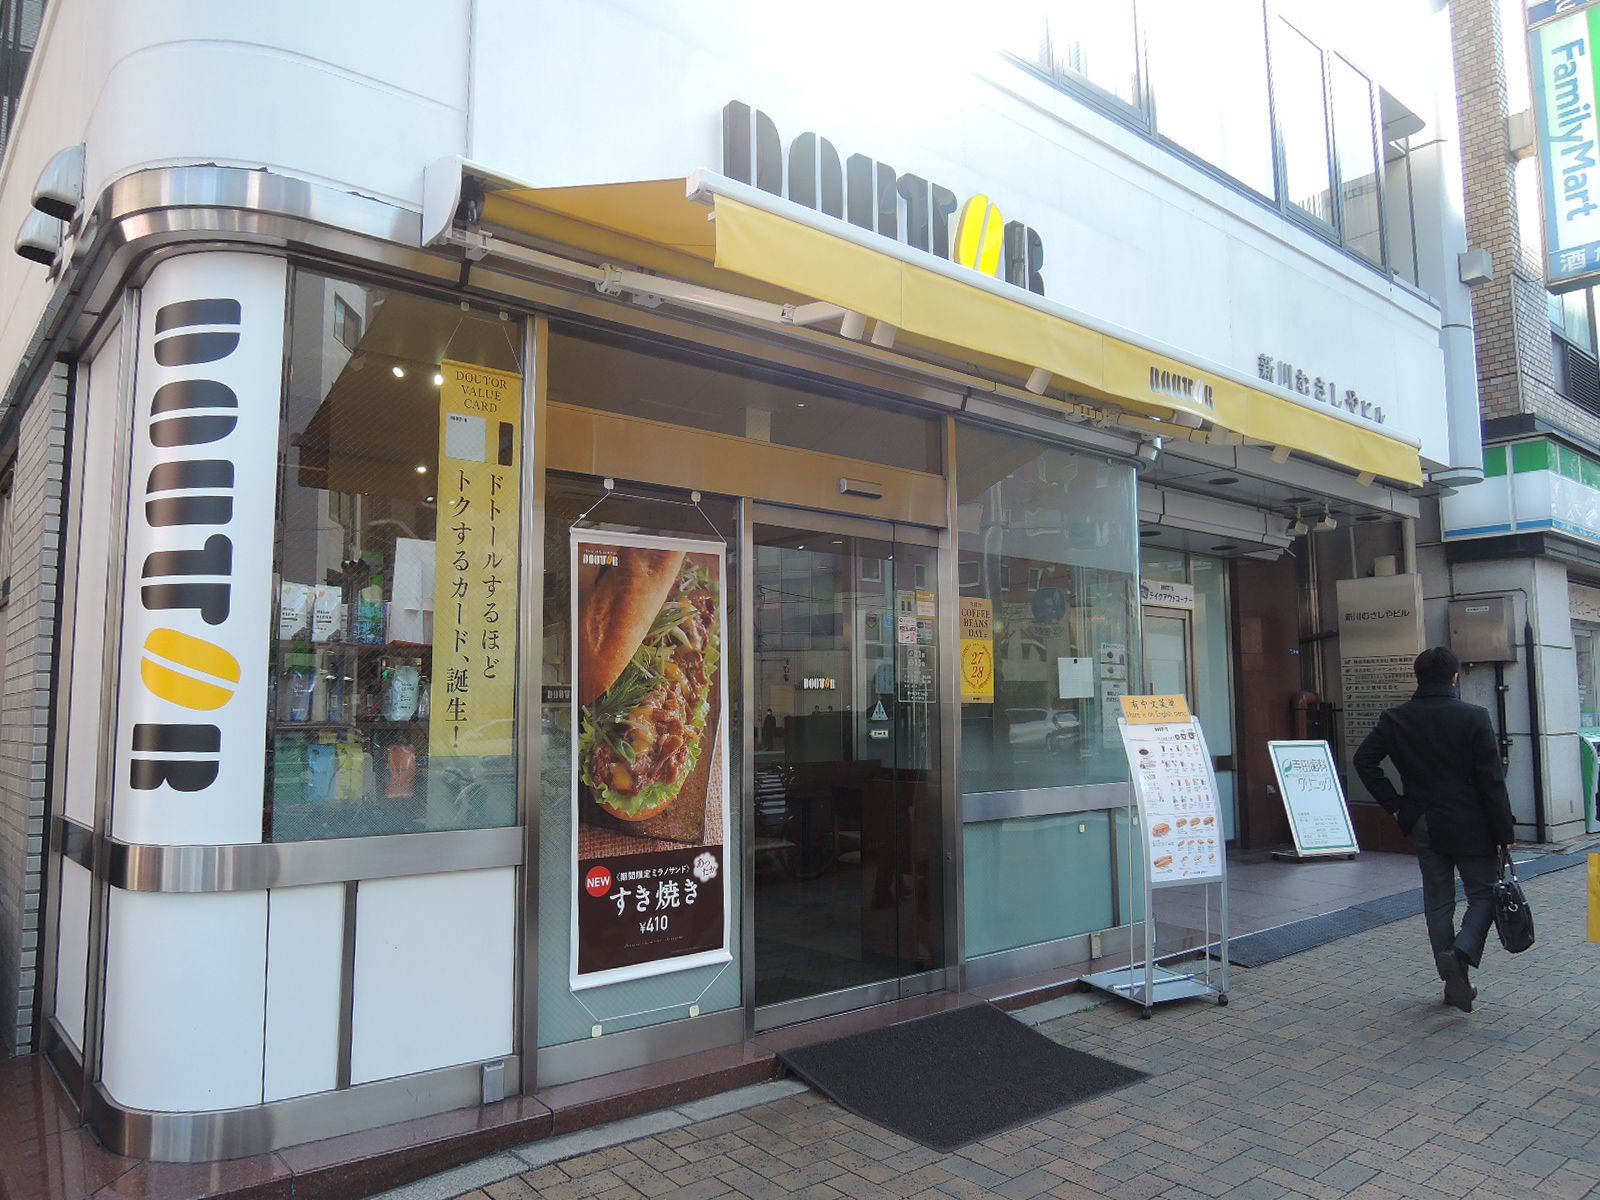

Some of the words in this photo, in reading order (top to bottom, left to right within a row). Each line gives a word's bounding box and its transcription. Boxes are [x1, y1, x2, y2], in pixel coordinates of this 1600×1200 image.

[1550, 38, 1599, 222] FamilyMart
[722, 99, 1046, 297] DOUTOR
[1560, 254, 1587, 272] 酒
[456, 371, 507, 389] DOUTOR
[461, 385, 501, 401] VALUE
[1150, 366, 1214, 411] DOUTOR
[1257, 353, 1386, 424] 新川むさしやビル
[464, 399, 497, 413] CARD
[129, 297, 242, 793] DOUTOR
[582, 553, 619, 567] DOUTOR
[482, 473, 504, 679] ドトールするほど
[961, 608, 991, 619] COFFEE
[1345, 609, 1410, 621] 新川むさしやビル
[963, 618, 988, 629] BEANS
[968, 628, 984, 638] DAY
[970, 651, 985, 665] 27
[970, 666, 985, 679] 28
[1298, 777, 1332, 792] クリニック
[586, 875, 611, 888] NEW
[609, 878, 698, 916] すき焼き
[639, 914, 669, 934] ¥410
